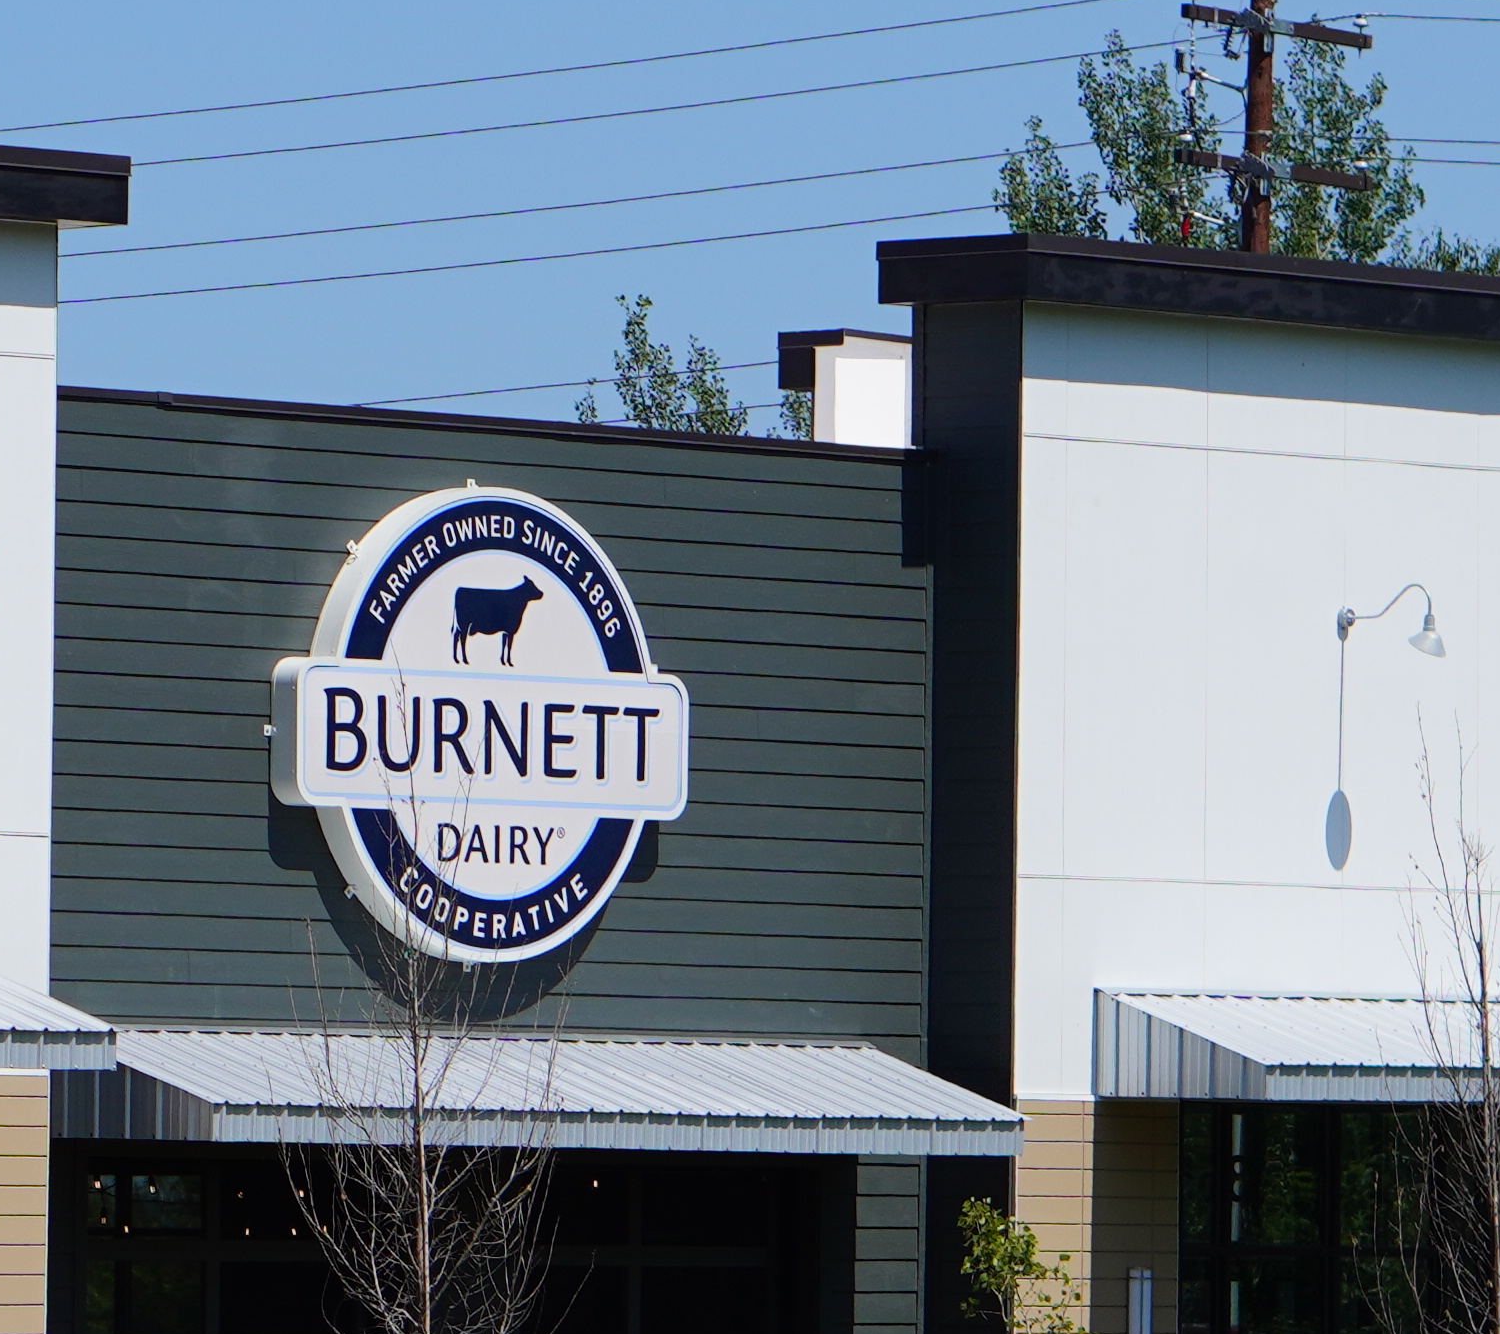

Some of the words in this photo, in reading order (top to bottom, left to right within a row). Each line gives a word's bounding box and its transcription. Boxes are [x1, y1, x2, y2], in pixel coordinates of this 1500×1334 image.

[369, 534, 441, 624] FARMER
[442, 515, 515, 548] OWNED
[521, 519, 580, 575] SINCE
[578, 571, 621, 638] 1896
[323, 687, 661, 783] BURNETT
[399, 866, 589, 939] COOPERATIVE
